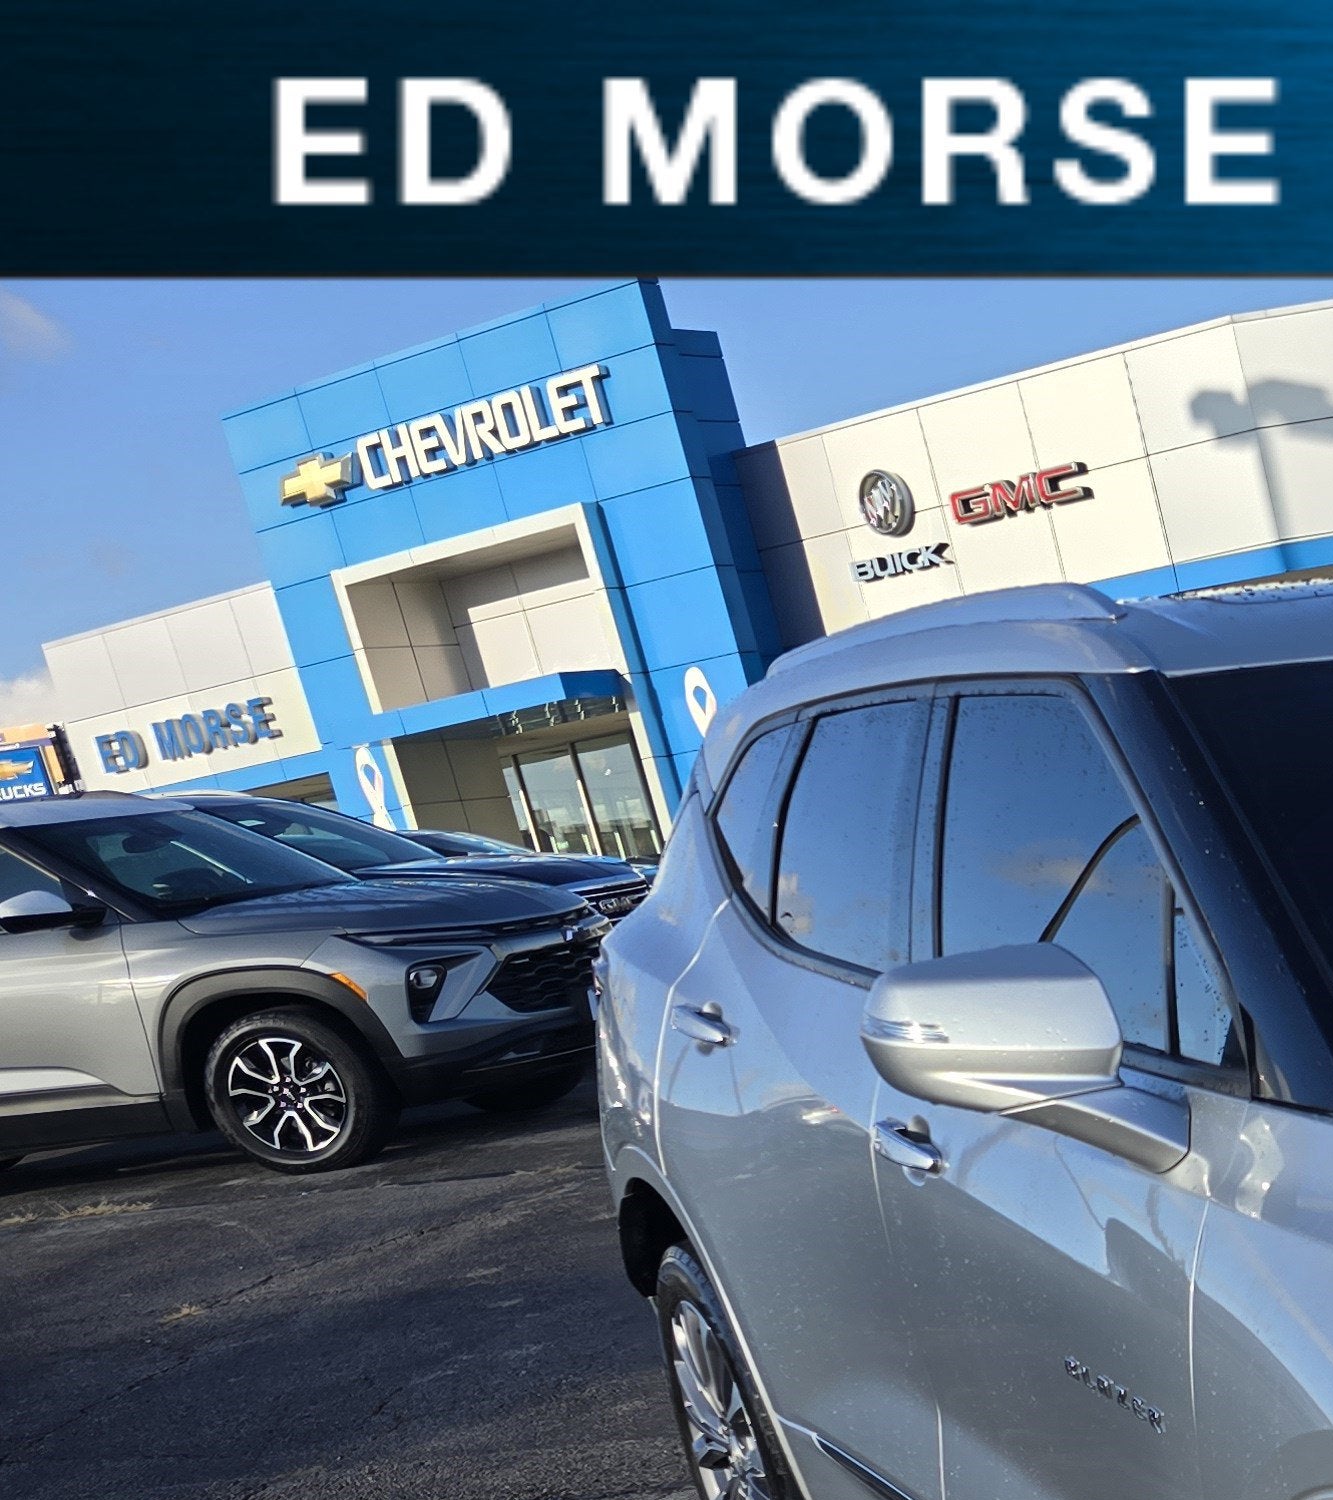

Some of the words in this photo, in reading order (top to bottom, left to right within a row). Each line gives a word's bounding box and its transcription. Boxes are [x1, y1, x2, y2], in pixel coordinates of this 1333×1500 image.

[356, 363, 609, 491] CHEVROLET
[950, 461, 1092, 526] GMC
[850, 542, 953, 582] BUICK
[94, 729, 150, 774] ED
[152, 696, 284, 761] MORSE
[0, 782, 48, 801] UCKS
